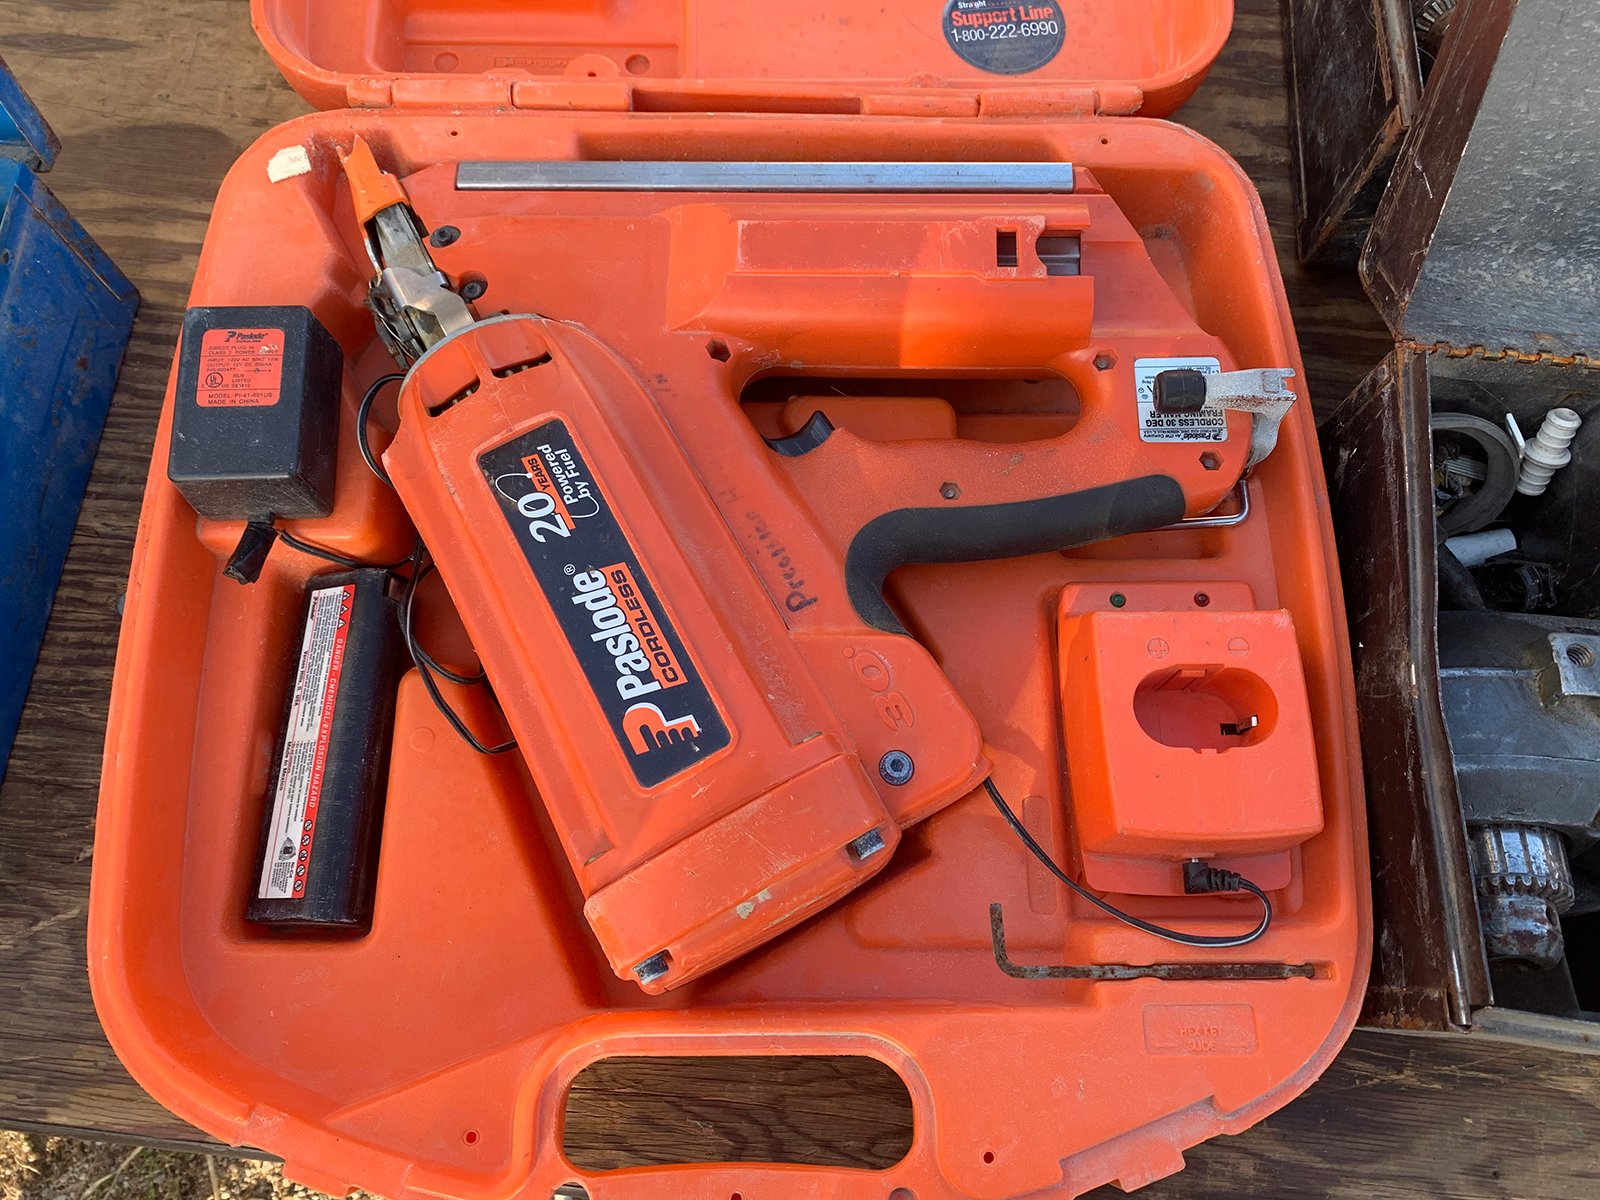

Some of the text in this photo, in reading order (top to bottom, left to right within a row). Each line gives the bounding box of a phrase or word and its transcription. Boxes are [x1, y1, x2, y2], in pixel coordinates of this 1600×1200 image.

[951, 4, 1054, 28] Support Line
[958, 0, 986, 9] Straght
[950, 20, 1058, 42] 1-800-222-6990
[1178, 418, 1224, 426] CORDLESS
[536, 444, 579, 505] Powered
[554, 448, 592, 499] by Fuel
[518, 458, 572, 543] 20 YEARS
[612, 568, 680, 683] CORDLESS
[331, 637, 343, 670] DANGER
[308, 773, 320, 807] HAZARD
[1179, 1025, 1222, 1037] HEX KEY
